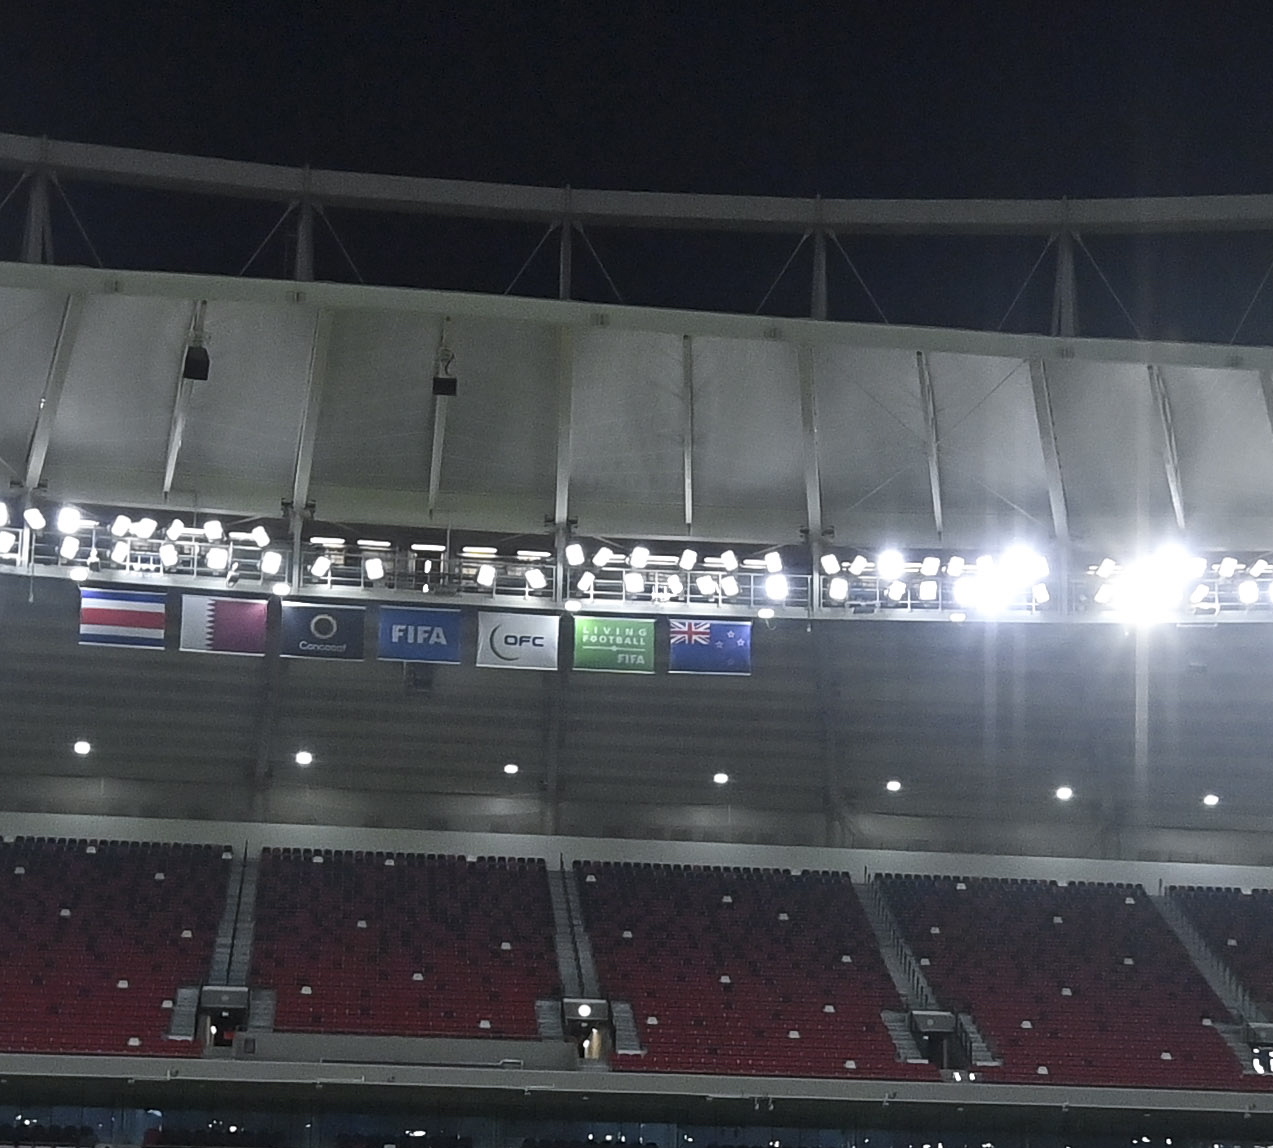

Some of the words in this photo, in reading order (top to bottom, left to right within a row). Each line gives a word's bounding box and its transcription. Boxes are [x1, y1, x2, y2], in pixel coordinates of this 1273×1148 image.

[392, 624, 447, 644] FIFA
[583, 626, 647, 636] LIVING
[504, 635, 544, 647] OFC
[582, 635, 646, 646] FOOTBALL
[617, 653, 645, 664] FIFA
